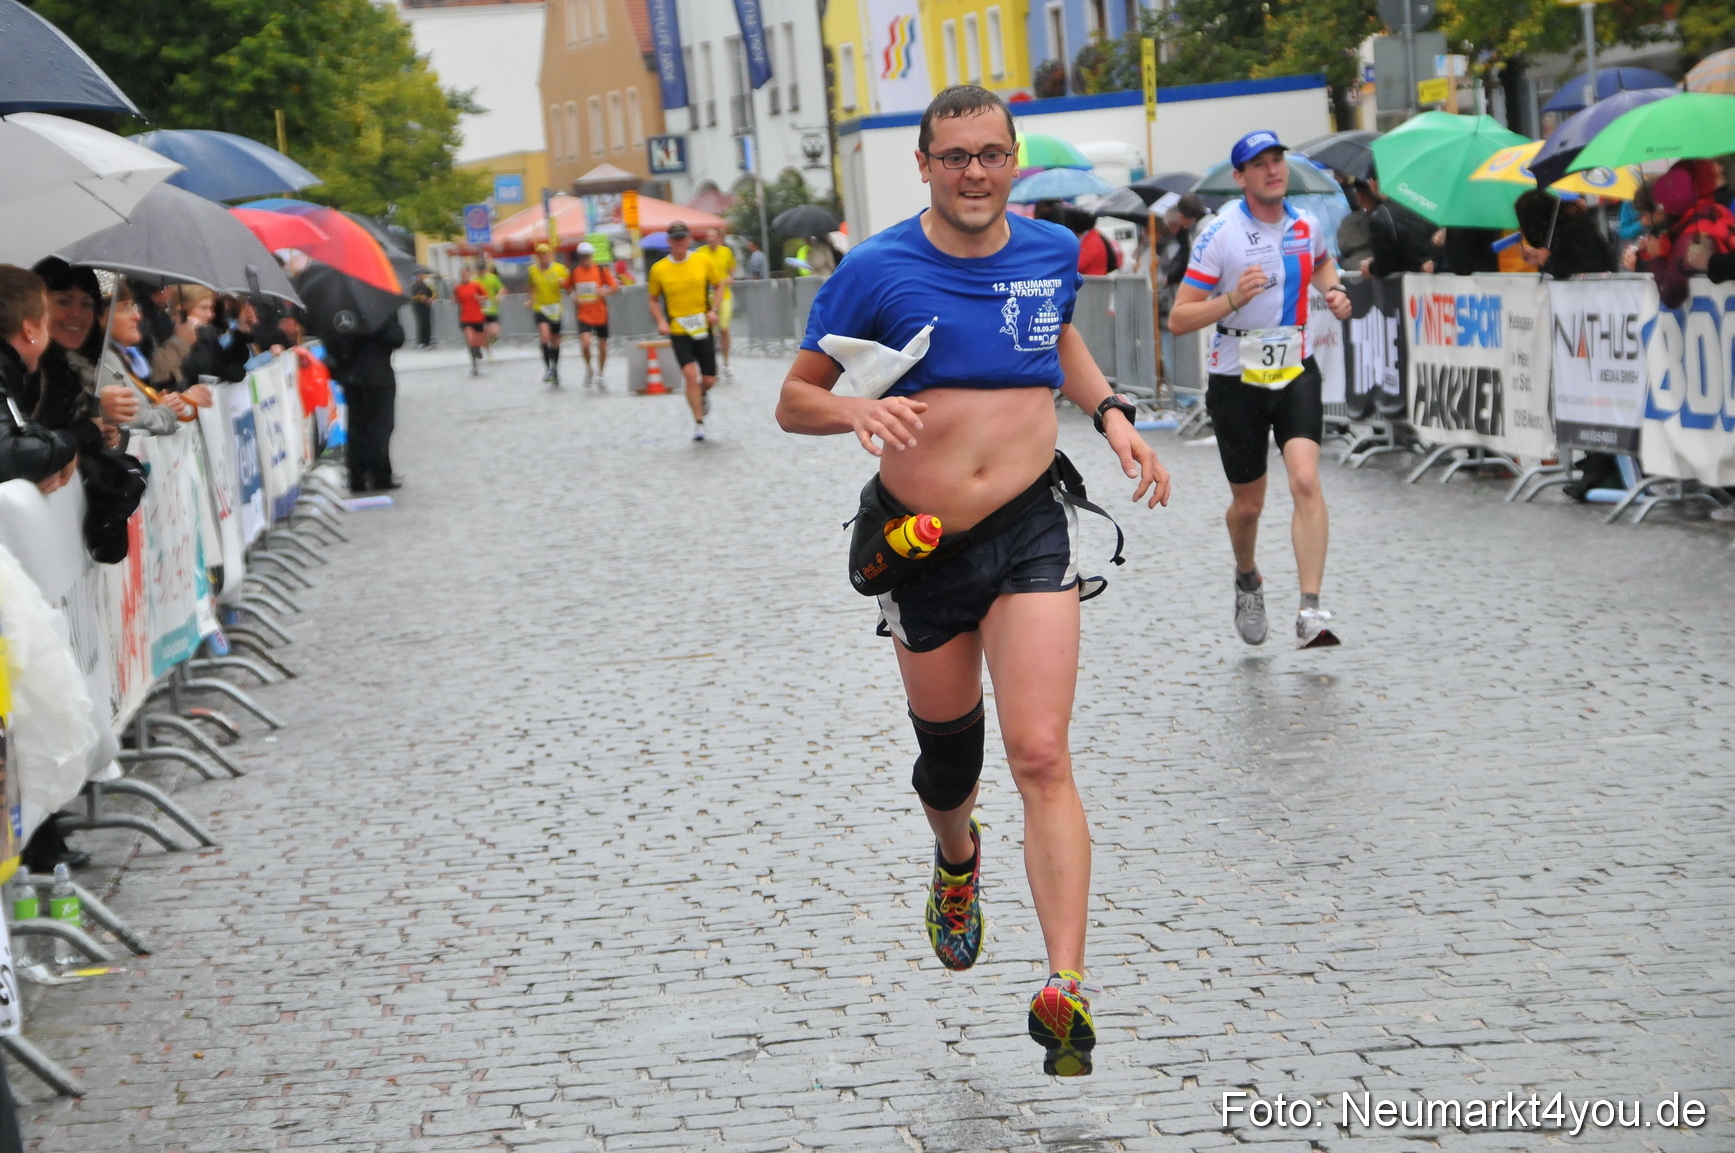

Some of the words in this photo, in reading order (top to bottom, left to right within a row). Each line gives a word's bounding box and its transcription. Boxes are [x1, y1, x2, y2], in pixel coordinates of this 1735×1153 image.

[992, 282, 1009, 292] 12.
[1010, 279, 1062, 289] NEUMARKTER
[1010, 288, 1055, 297] STADTLAUF
[1554, 309, 1640, 363] NATHUS
[1262, 344, 1288, 367] 37
